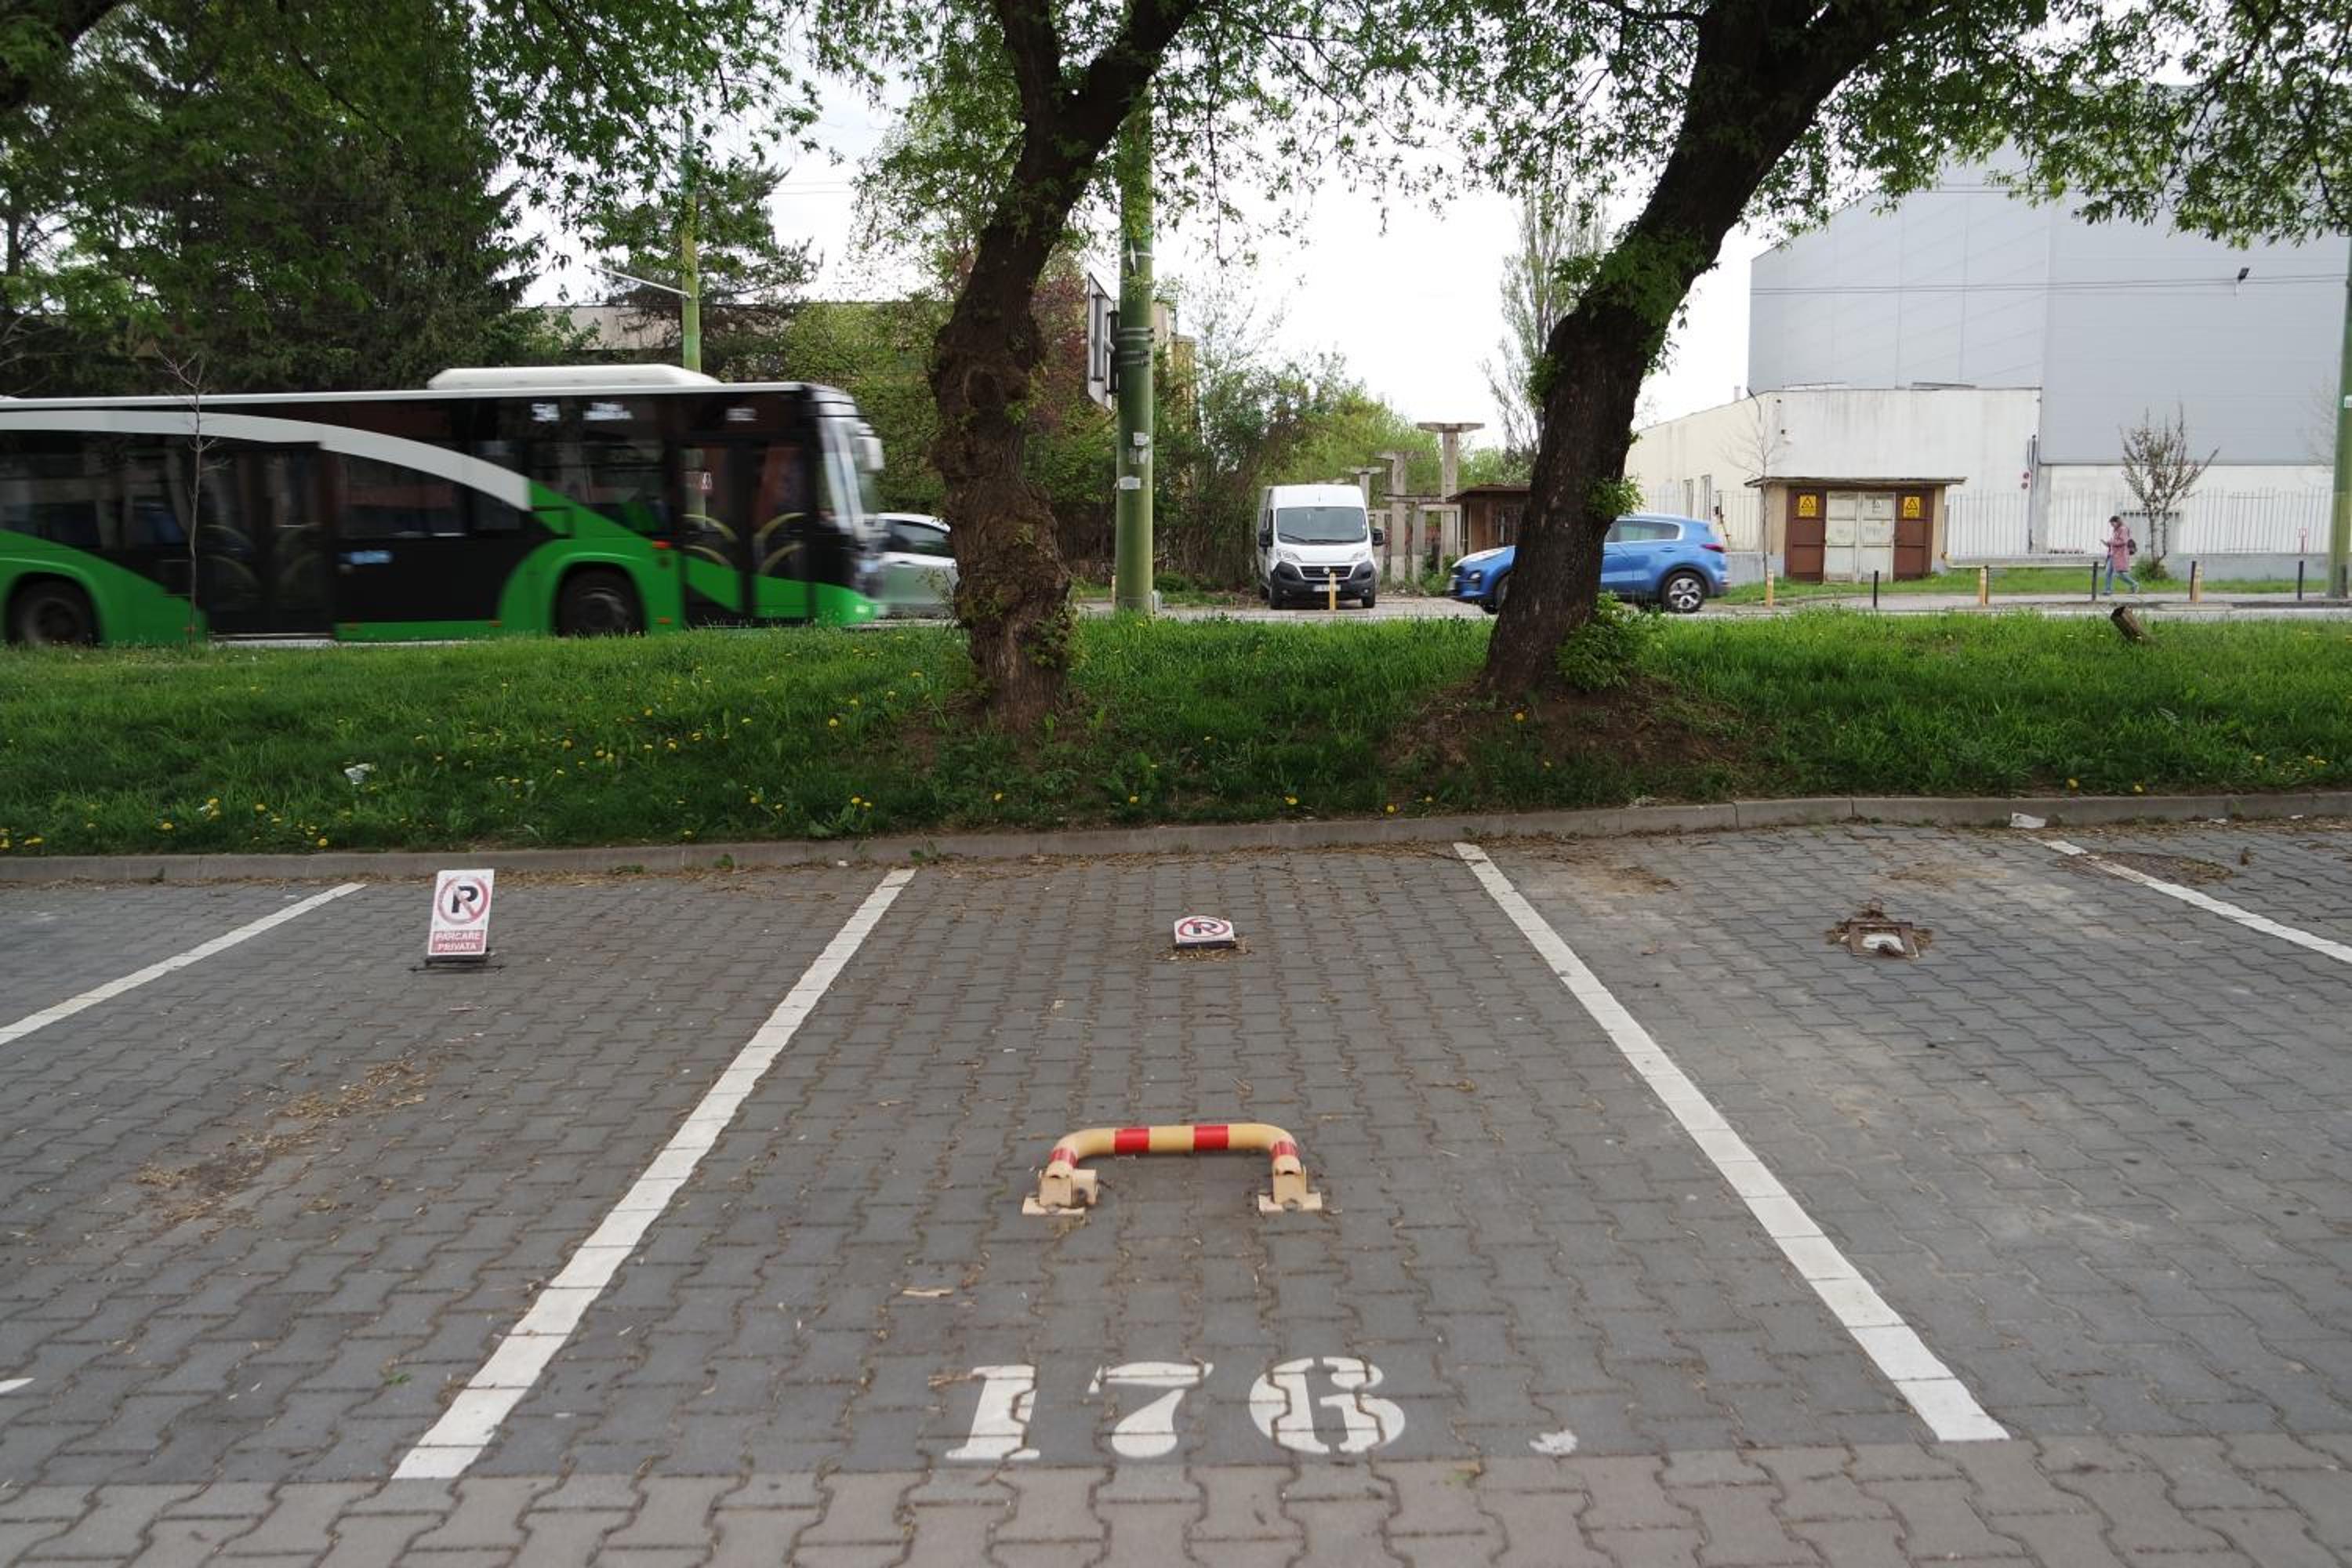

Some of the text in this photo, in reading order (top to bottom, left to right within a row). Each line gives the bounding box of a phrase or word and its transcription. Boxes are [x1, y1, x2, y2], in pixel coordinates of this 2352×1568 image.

[451, 885, 479, 913] P
[435, 931, 481, 942] PARCARE
[438, 942, 477, 951] PRIVATA
[946, 1356, 1405, 1459] 176
